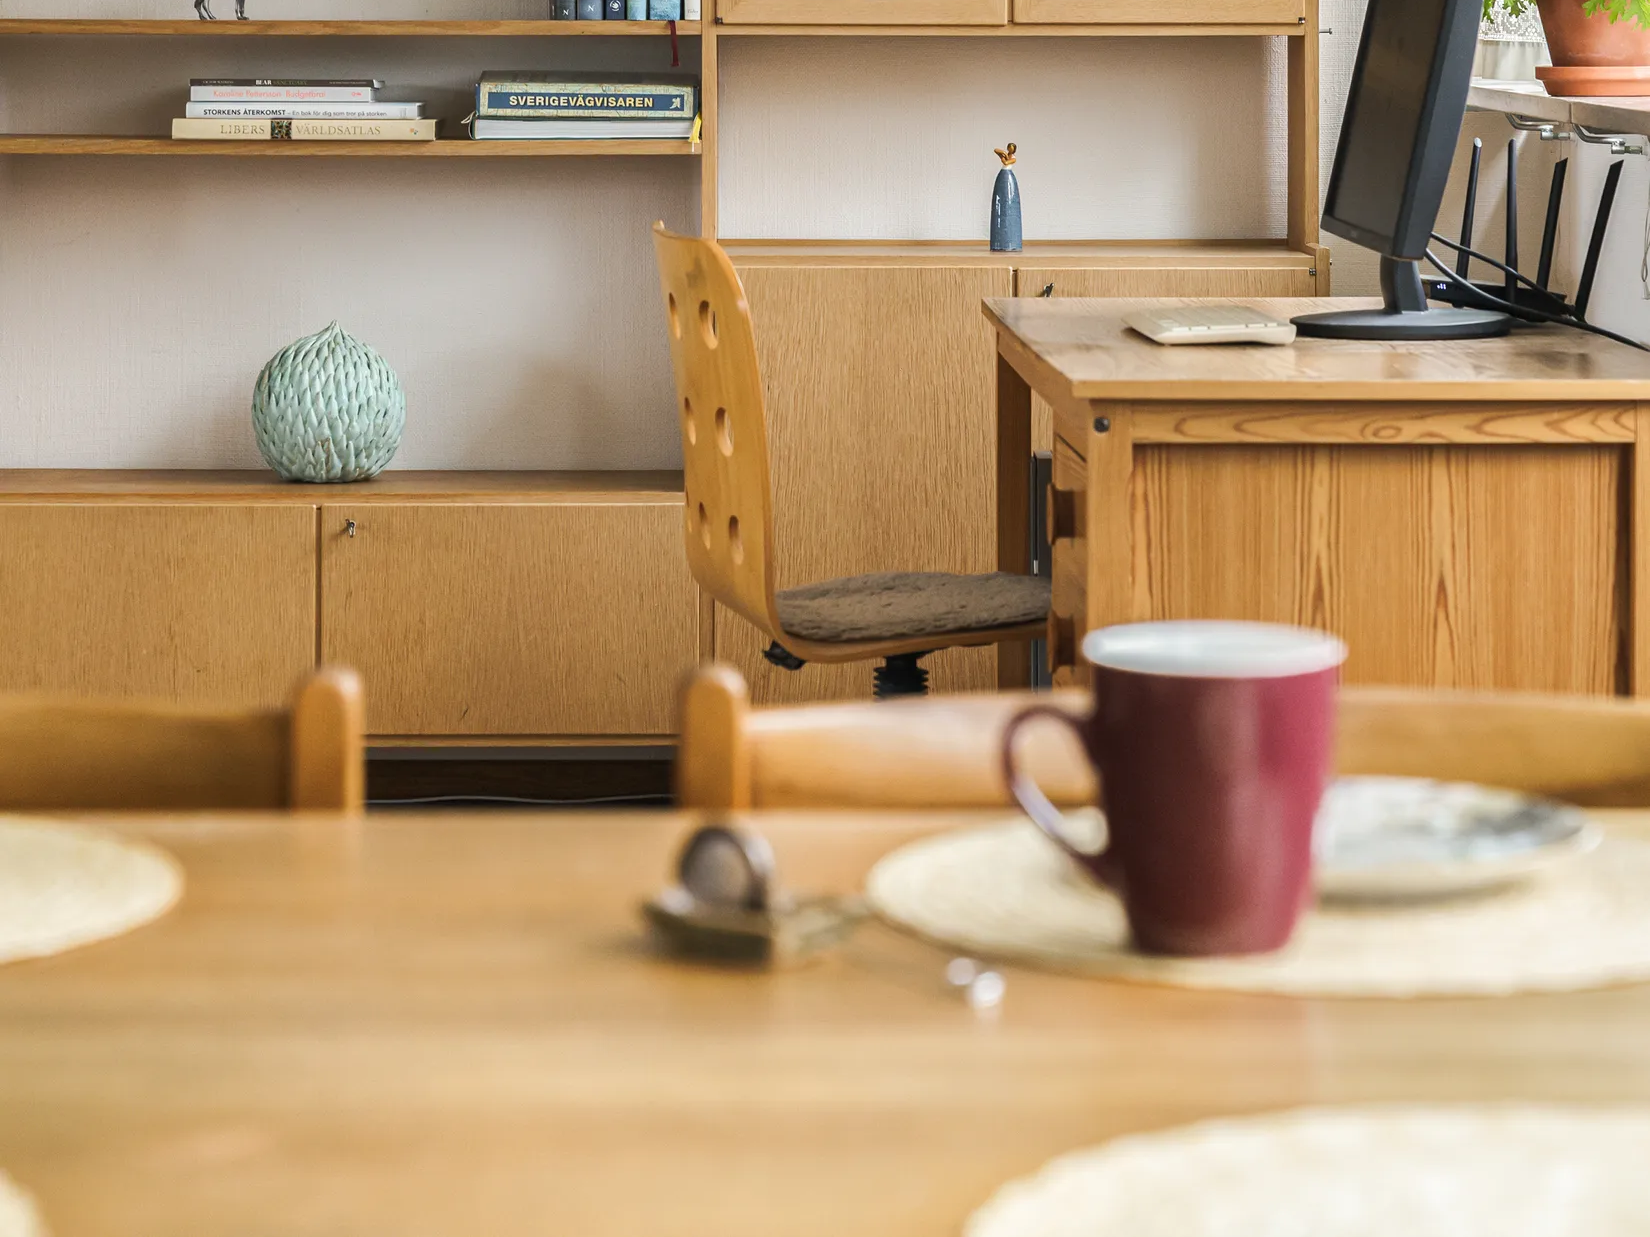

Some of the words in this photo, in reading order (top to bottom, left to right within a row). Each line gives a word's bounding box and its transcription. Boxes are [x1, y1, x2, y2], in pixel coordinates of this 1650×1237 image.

[509, 94, 653, 108] SVERIGEVÄGVISAREN
[243, 108, 286, 116] ÅTERKOMST
[220, 124, 265, 135] LIBERS
[295, 123, 381, 135] VÄRLDSATLAS
